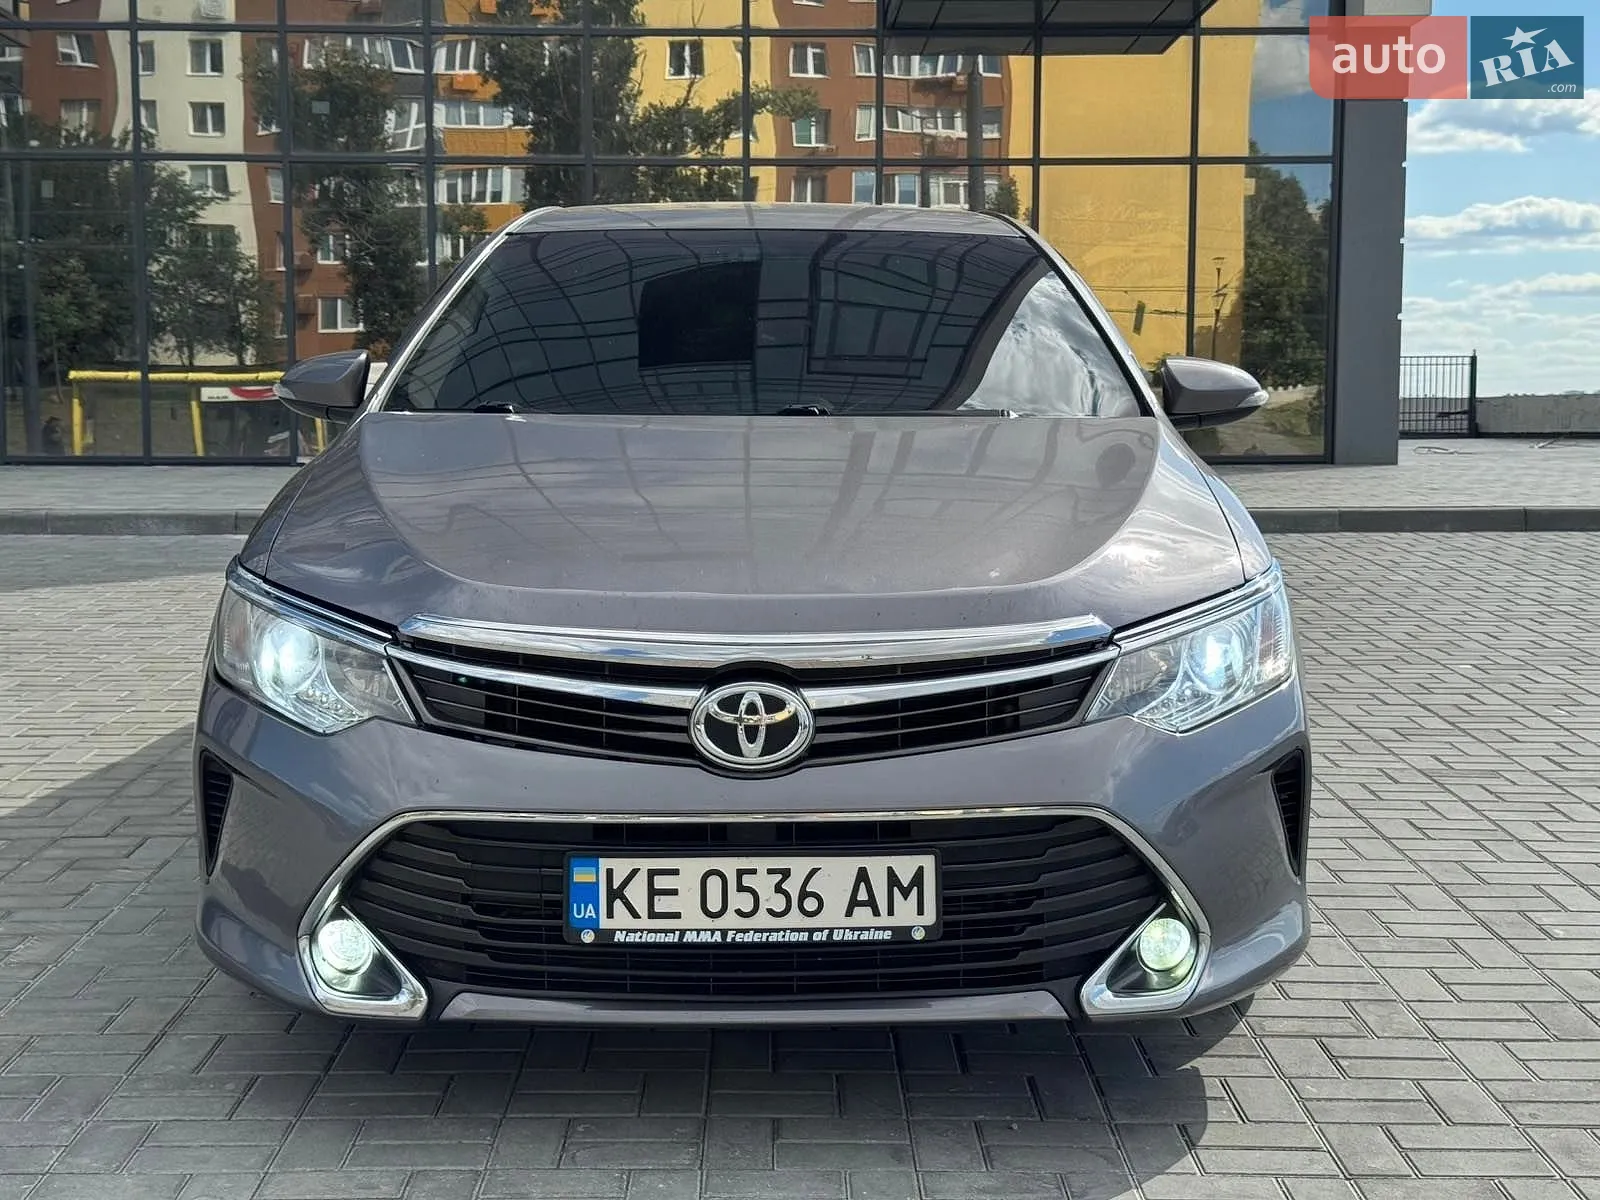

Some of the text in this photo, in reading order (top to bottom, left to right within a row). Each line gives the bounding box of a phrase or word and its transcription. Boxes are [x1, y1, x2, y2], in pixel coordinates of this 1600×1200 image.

[605, 865, 925, 920] KE 0536 AM
[573, 903, 597, 919] UA
[613, 928, 892, 943] National MMA Federation of Ukraine
